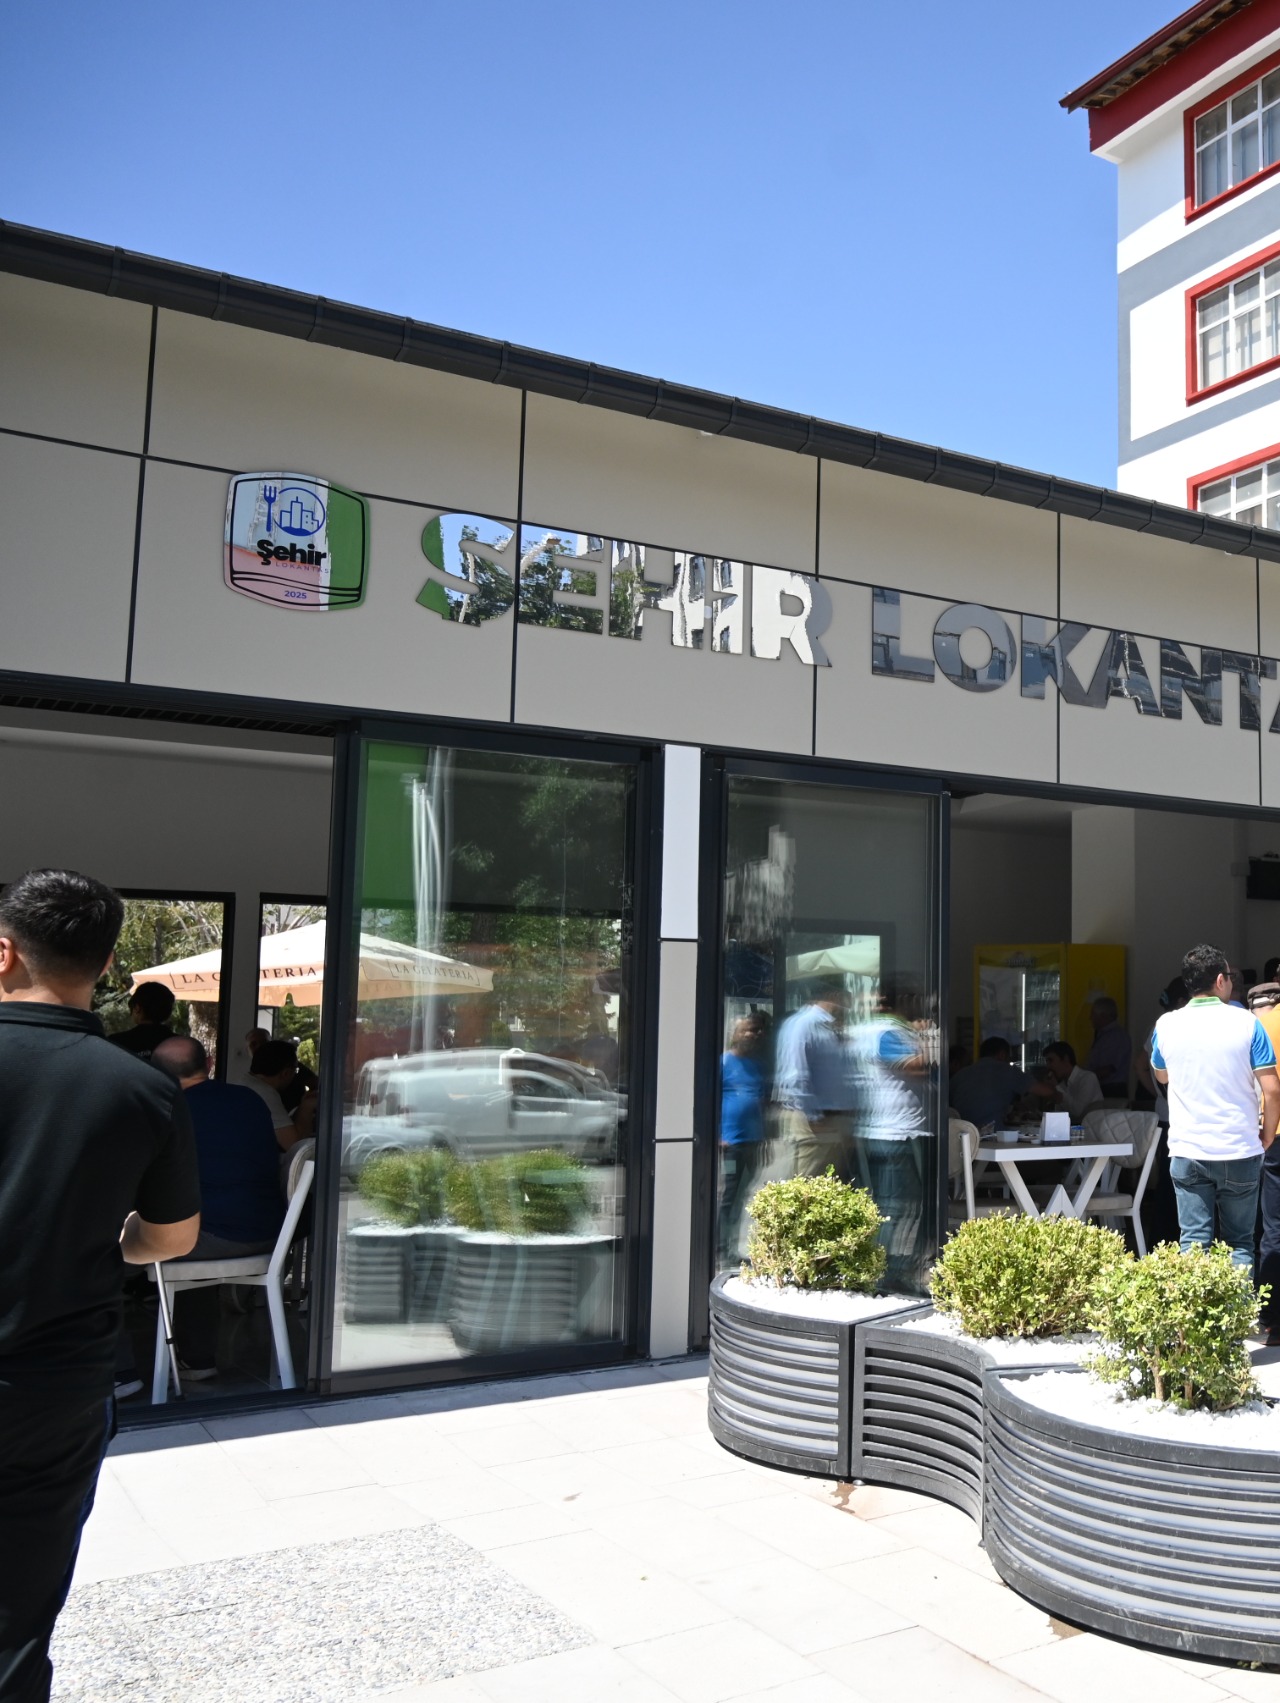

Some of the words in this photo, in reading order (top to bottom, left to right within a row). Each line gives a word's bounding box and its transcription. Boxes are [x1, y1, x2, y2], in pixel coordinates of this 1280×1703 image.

[256, 539, 327, 566] Şehir
[284, 590, 307, 599] 2025
[181, 973, 205, 984] LA
